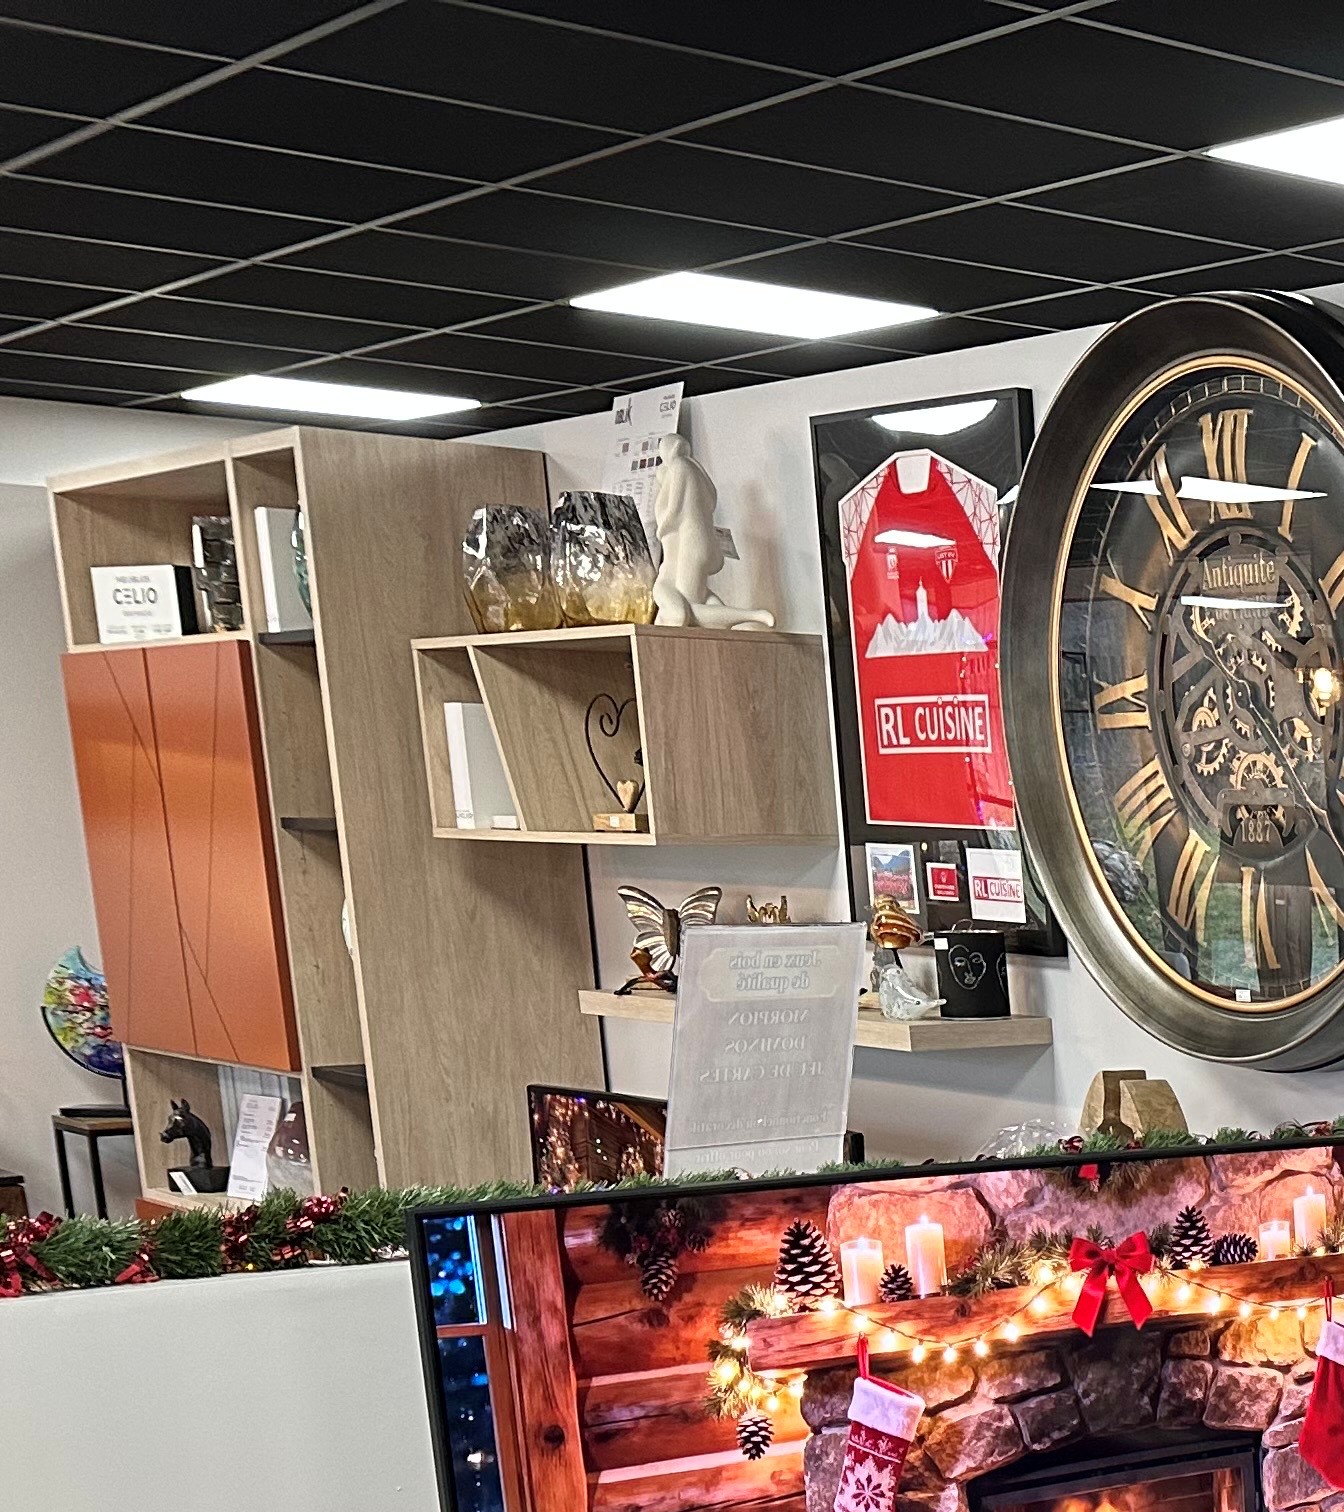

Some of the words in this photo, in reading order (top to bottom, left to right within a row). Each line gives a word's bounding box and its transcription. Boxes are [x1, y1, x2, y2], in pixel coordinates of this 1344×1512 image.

[880, 706, 911, 746] RL
[1241, 818, 1272, 843] 1887
[975, 878, 989, 898] RL
